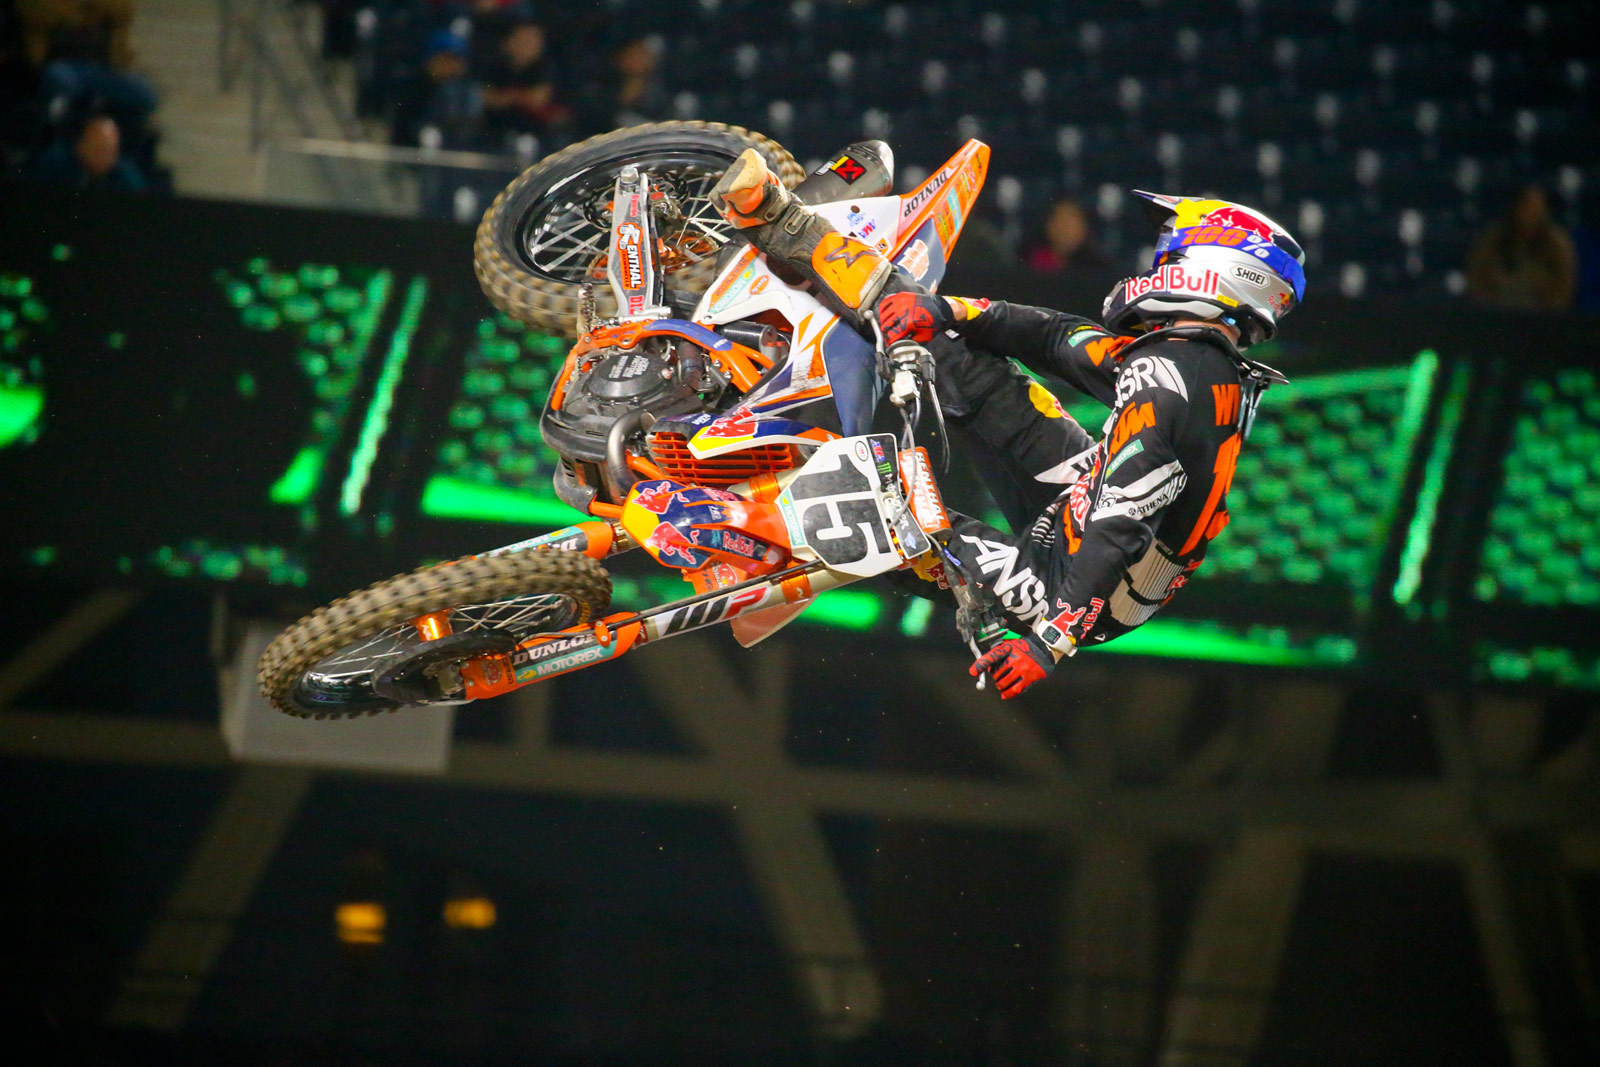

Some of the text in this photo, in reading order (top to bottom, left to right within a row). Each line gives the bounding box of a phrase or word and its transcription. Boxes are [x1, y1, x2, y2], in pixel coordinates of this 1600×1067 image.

[904, 169, 948, 218] DUNLOP
[617, 222, 643, 290] RENTHAL
[1180, 225, 1269, 259] 100%
[1125, 264, 1219, 302] Red Bull
[1235, 266, 1266, 286] SHOEI
[1109, 443, 1140, 471] MOTOREX
[915, 452, 944, 527] RENTHAL
[1136, 493, 1169, 516] ATHENA
[783, 502, 803, 547] MOTOREX
[789, 453, 892, 566] 15
[723, 531, 755, 557] Red Bull
[663, 587, 772, 636] WP
[1085, 597, 1105, 624] Bull
[537, 648, 604, 677] MOTOREX
